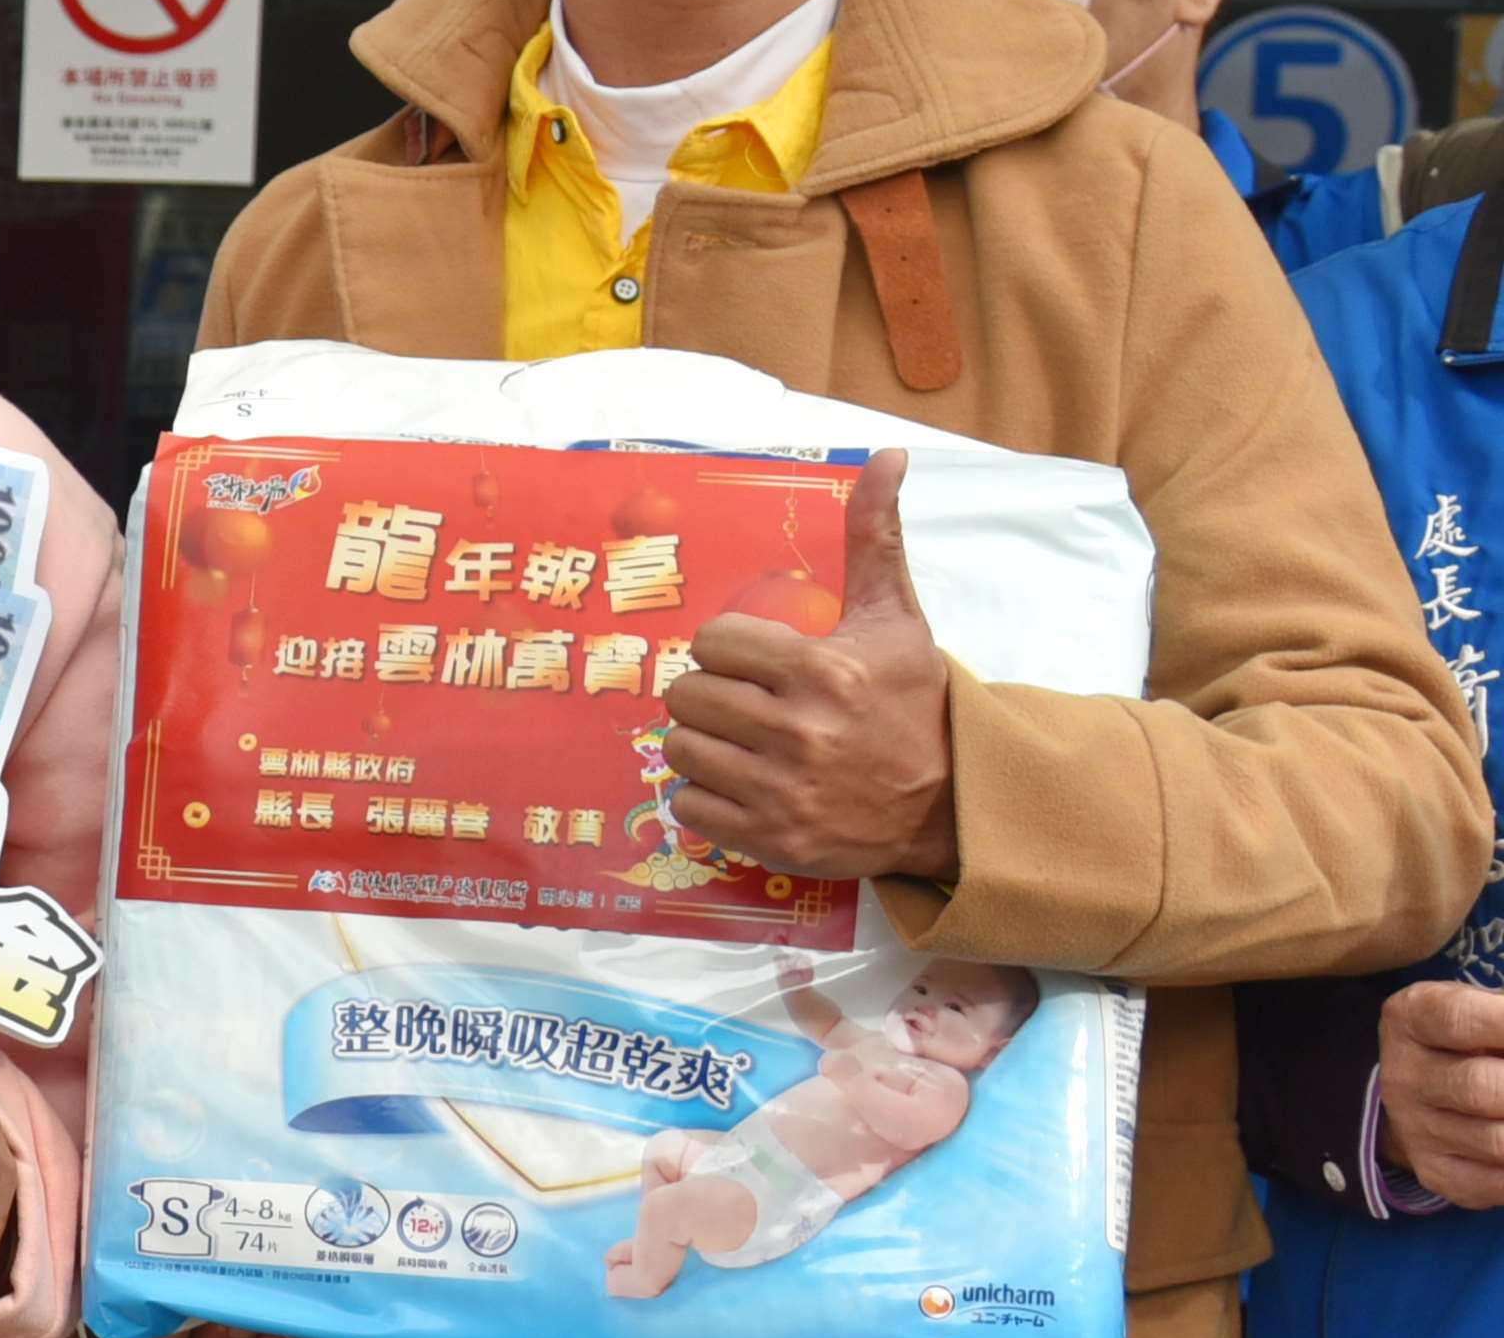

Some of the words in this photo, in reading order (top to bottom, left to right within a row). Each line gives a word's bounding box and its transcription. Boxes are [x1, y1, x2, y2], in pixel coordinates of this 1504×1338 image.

[1250, 39, 1349, 176] 5
[322, 497, 687, 617] 龍年報喜
[257, 746, 418, 785] 雲林縣政府
[253, 788, 336, 833] 縣長
[365, 794, 491, 844] 張麗善
[521, 803, 608, 849] 敬賀
[331, 997, 737, 1108] 整晚瞬吸超乾爽
[161, 1196, 190, 1236] S
[224, 1198, 275, 1221] 4~8
[962, 1282, 1056, 1307] unicharm
